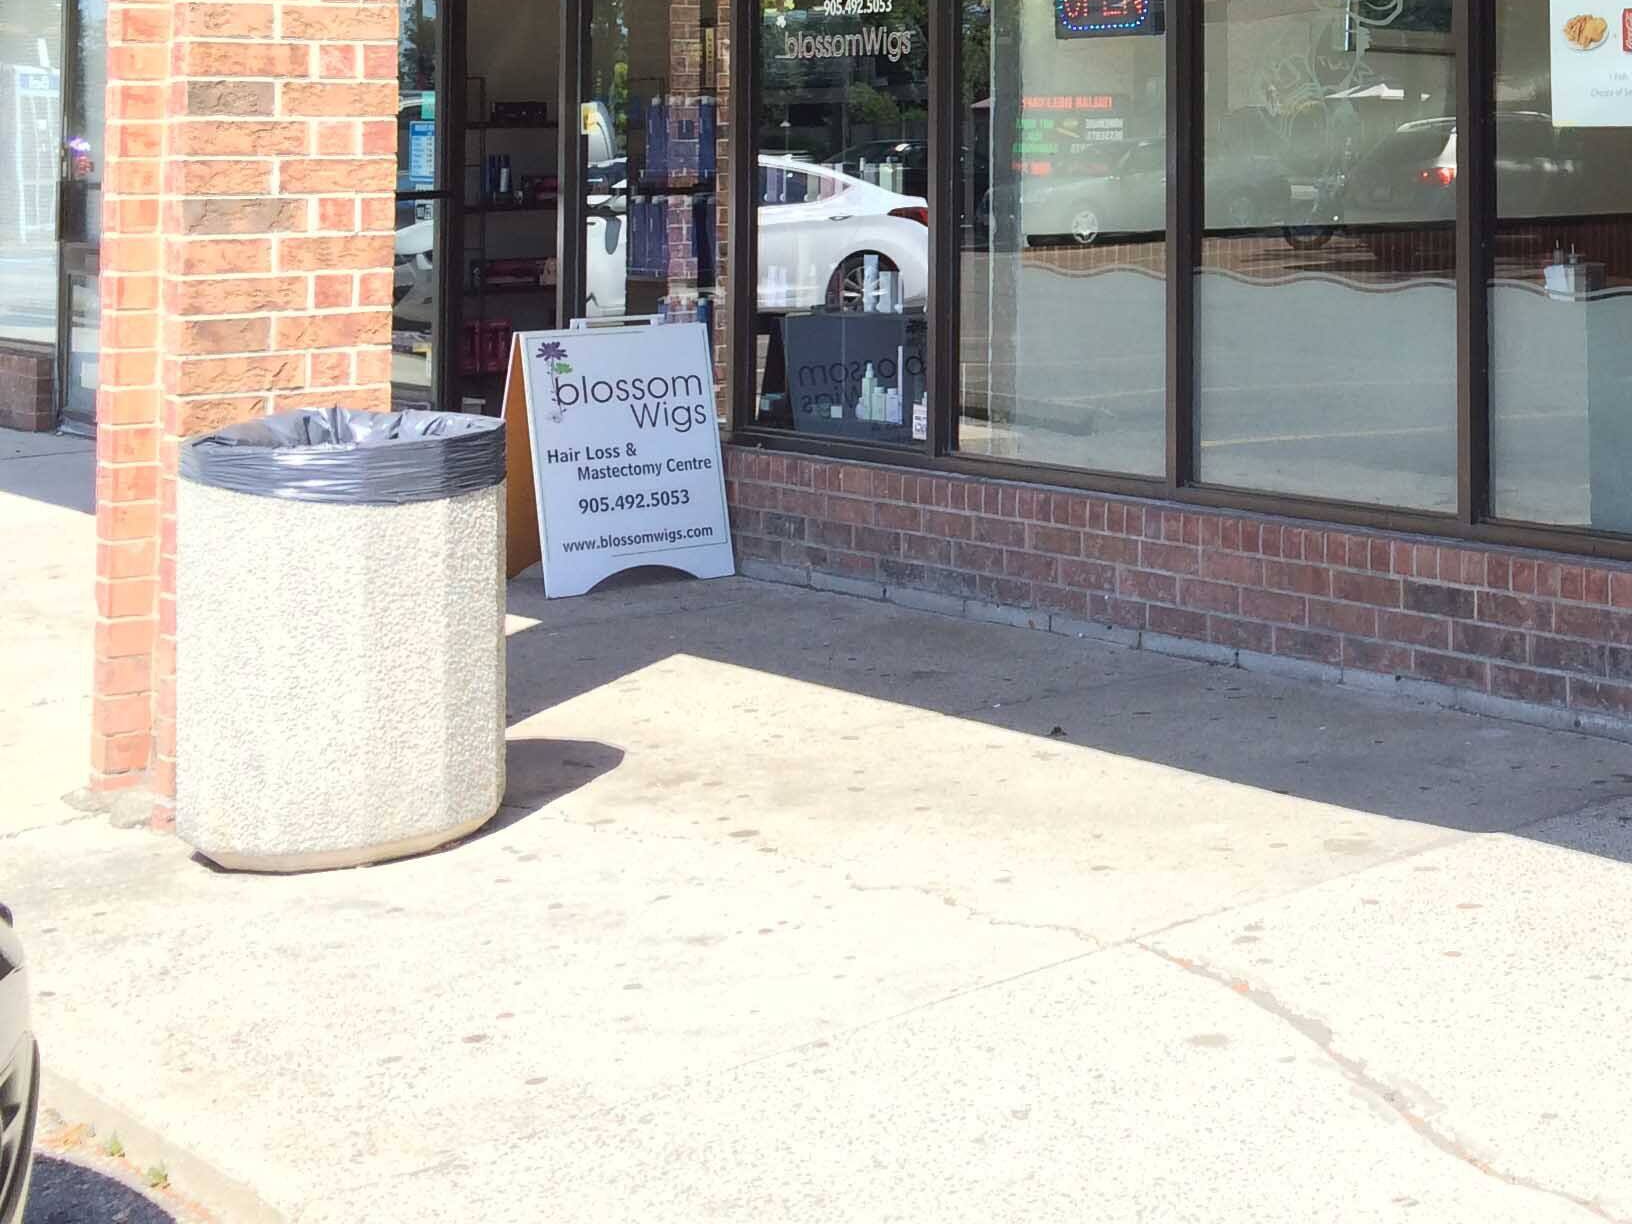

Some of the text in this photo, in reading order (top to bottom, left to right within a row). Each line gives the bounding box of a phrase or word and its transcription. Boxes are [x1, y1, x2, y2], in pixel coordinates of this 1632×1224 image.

[555, 374, 703, 406] blossom
[630, 401, 707, 433] Wigs
[547, 442, 637, 464] Hair Loss &
[577, 457, 712, 481] Mastectomy Centre
[578, 488, 690, 515] 905.492.5053
[562, 525, 713, 553] www.blossomwigs.com
